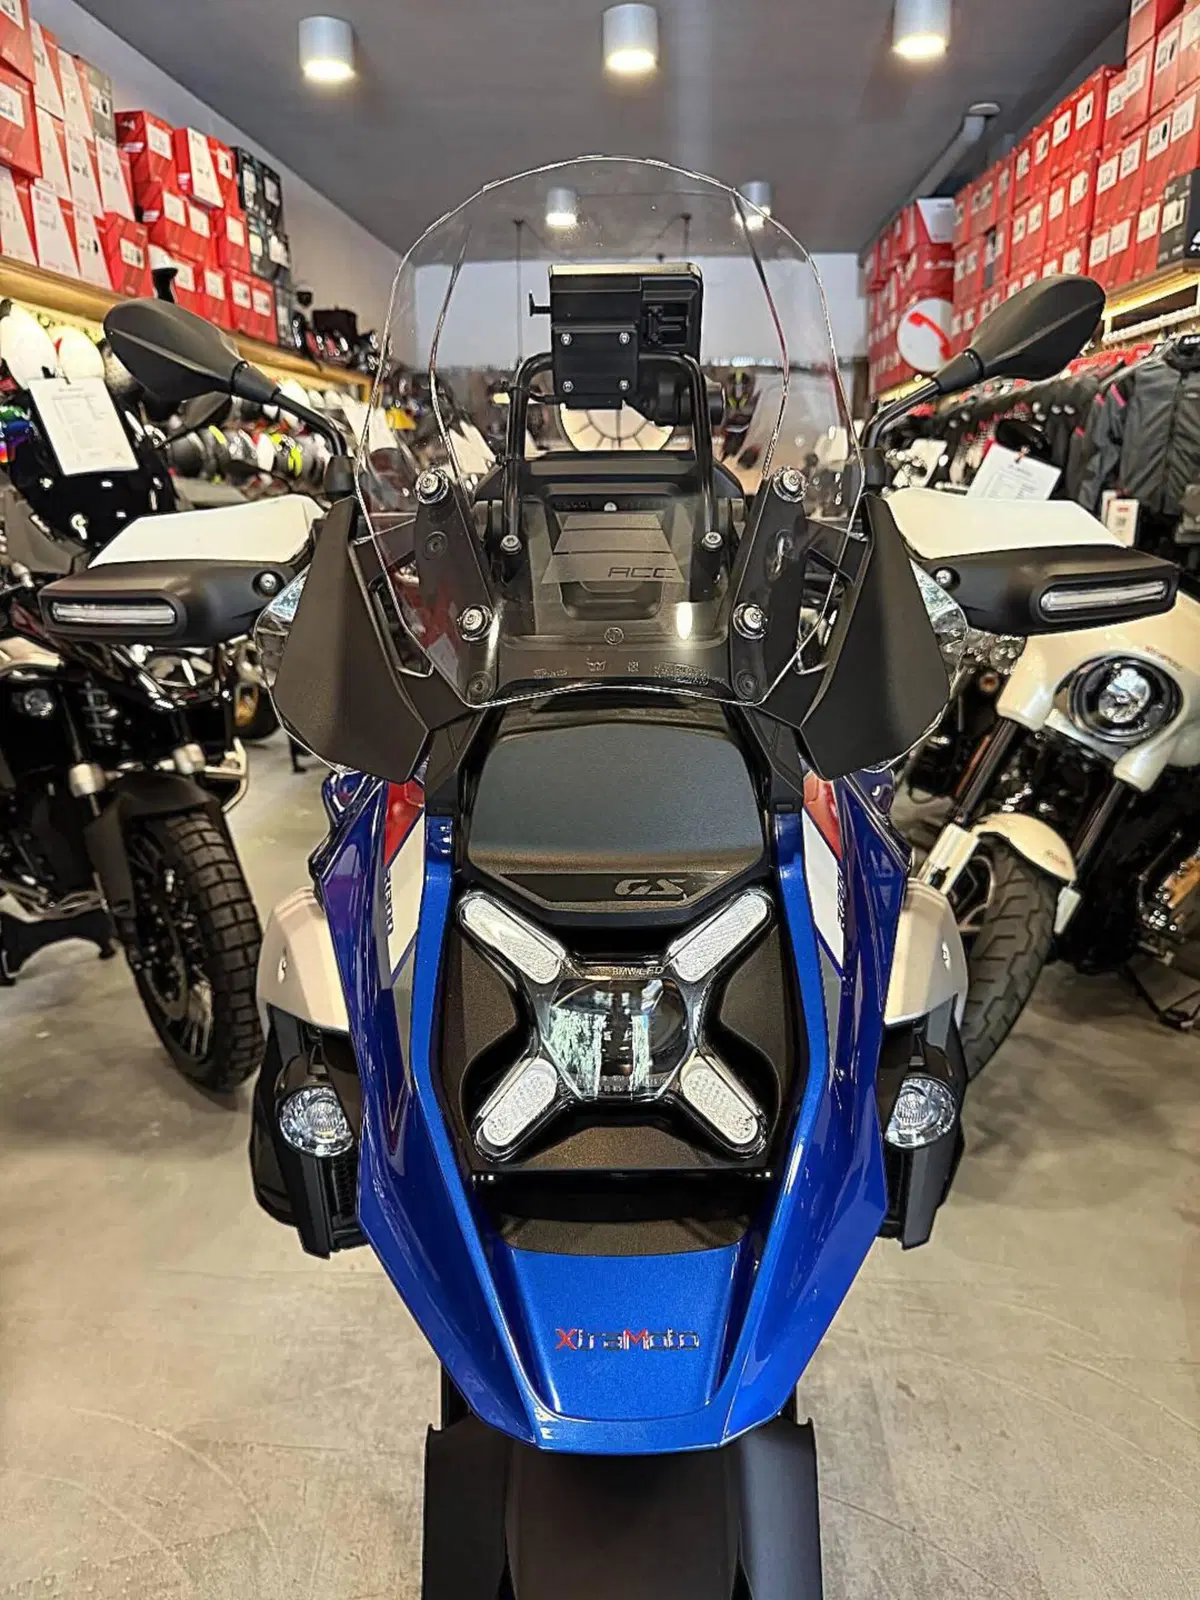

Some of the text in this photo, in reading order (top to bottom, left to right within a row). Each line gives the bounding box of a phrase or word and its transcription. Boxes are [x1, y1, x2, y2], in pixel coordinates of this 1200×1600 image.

[607, 566, 677, 579] ACC
[614, 879, 688, 896] GS
[555, 1326, 700, 1351] XtraMoto
